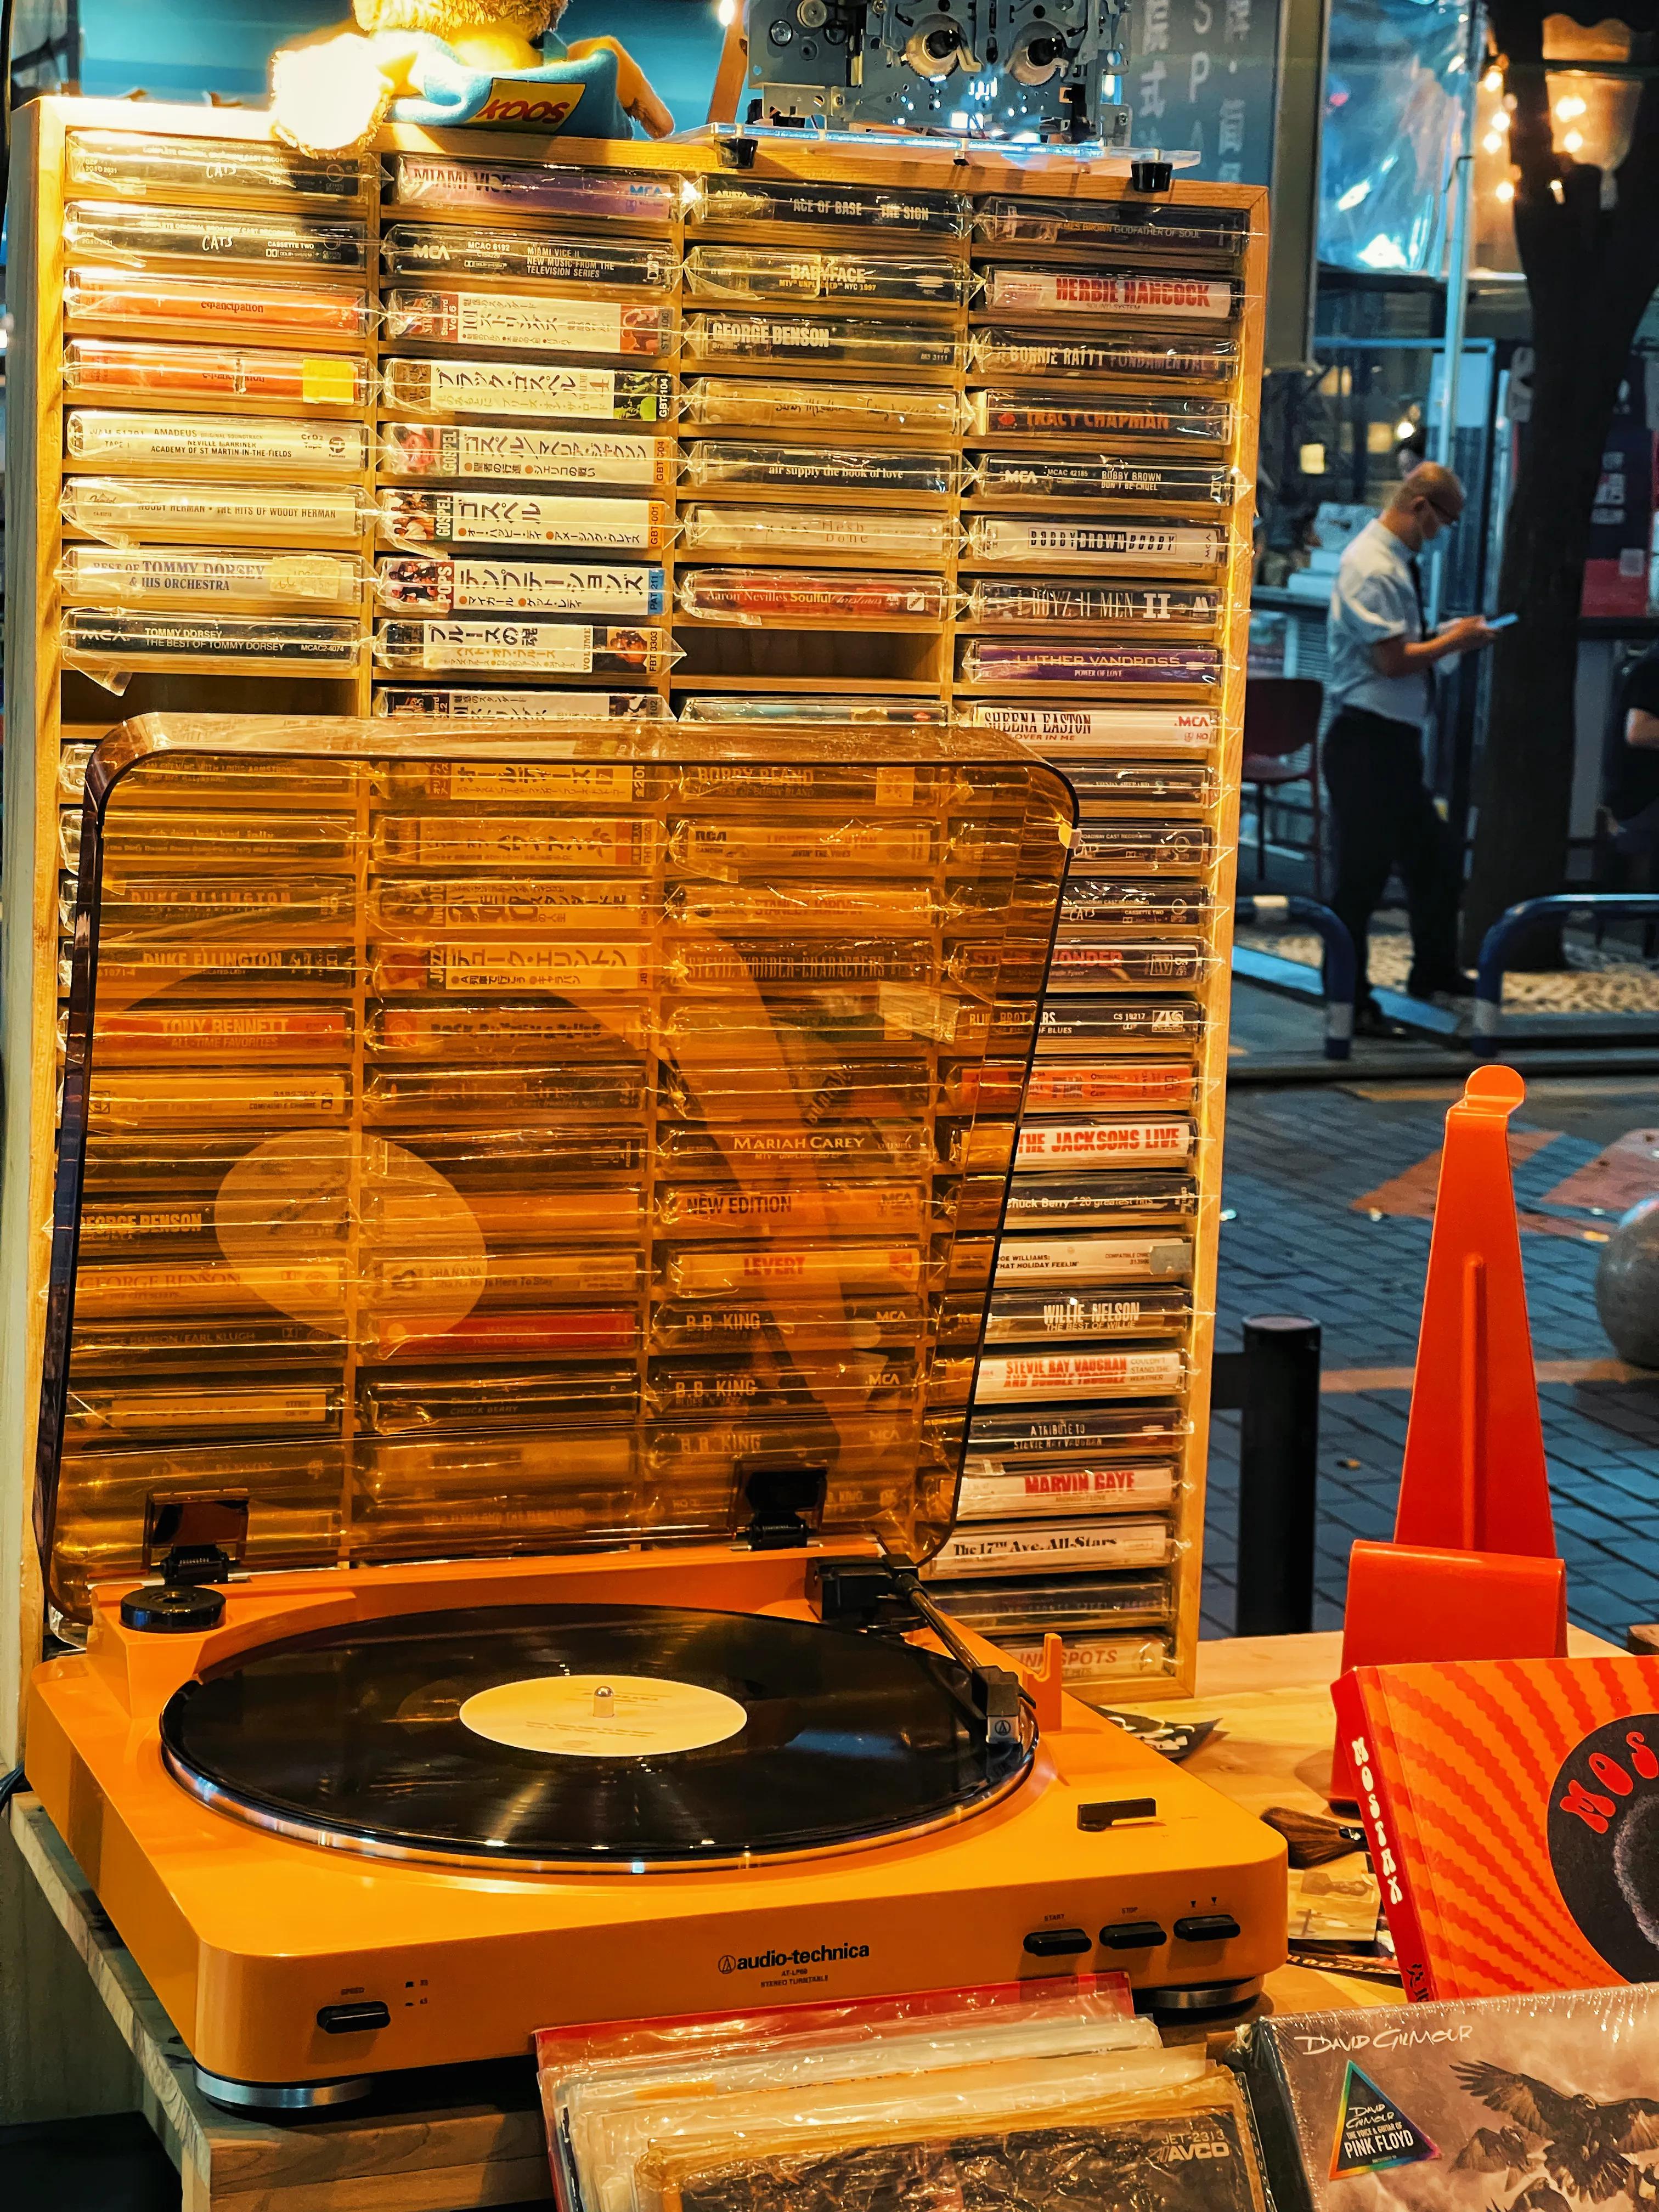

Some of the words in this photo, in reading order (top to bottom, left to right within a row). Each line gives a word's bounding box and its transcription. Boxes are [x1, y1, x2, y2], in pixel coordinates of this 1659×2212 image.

[475, 99, 570, 124] KOOS
[206, 163, 236, 179] CATS
[793, 199, 813, 213] ACE
[817, 200, 832, 213] OF
[835, 201, 862, 216] BASE
[881, 205, 900, 219] THE
[904, 206, 929, 220] SIGN
[202, 235, 233, 251] CATS
[467, 241, 490, 250] MCAC
[413, 244, 450, 261] MCA
[527, 257, 545, 266] NEW
[548, 258, 573, 267] MUSIC
[575, 259, 598, 270] FROM
[600, 261, 614, 270] THE
[527, 266, 571, 276] TELEVISION
[573, 268, 600, 278] SERIES
[1056, 278, 1118, 303] HERBIE
[1125, 281, 1210, 307] HANCOCK
[713, 323, 769, 344] GEORGE
[772, 326, 830, 347] BENSON
[437, 367, 577, 397] ブラック・ゴスペル
[589, 378, 610, 398] 4
[1026, 410, 1079, 428] TRACY
[1084, 411, 1169, 430] CHAPMAN
[211, 448, 292, 458] MARTIN-IN-THE-FIELDS
[443, 431, 458, 472] GOSPEL
[473, 462, 522, 475] 聖者の行進
[534, 465, 596, 478] ジェリコの戦い
[769, 465, 783, 475] air
[785, 465, 820, 478] supply
[823, 466, 839, 476] the
[842, 466, 868, 477] book
[870, 468, 881, 478] of
[883, 468, 904, 478] love
[1102, 471, 1128, 482] BOBBY
[1132, 472, 1161, 482] BROWN
[1005, 470, 1037, 484] MCA
[235, 506, 253, 515] HITS
[269, 508, 297, 517] WOODY
[301, 509, 336, 518] HERMAN
[436, 496, 452, 537] GOSPEL
[460, 499, 542, 524] ゴスペル
[650, 506, 659, 545] GBT-001
[125, 563, 140, 572] OF
[142, 560, 198, 577] TOMMY
[204, 562, 265, 579] DORSEY
[129, 578, 138, 586] &
[142, 577, 161, 588] HIS
[165, 579, 230, 591] ORCHESTRA
[437, 566, 452, 604] POPS
[460, 569, 644, 595] テンプテーションズ
[469, 595, 514, 607] マイガール
[527, 598, 583, 609] ゲット・レディ
[1080, 591, 1091, 617] II
[1101, 592, 1133, 618] MEN
[1143, 592, 1171, 619] II
[144, 628, 181, 637] TOMMY
[183, 629, 223, 639] DORSEY
[430, 624, 539, 647] ブルースの魂
[146, 638, 164, 647] THE
[166, 639, 191, 648] BEST
[194, 640, 207, 648] OF
[208, 640, 244, 650] TOMMY
[246, 642, 285, 651] DORSEY
[583, 628, 591, 671] VOLUME
[1015, 654, 1085, 667] LUTHER
[1090, 656, 1180, 667] VANDROSS
[984, 712, 1037, 732] SHEENA
[1043, 713, 1091, 735] EASTON
[696, 831, 727, 842] RCA
[1069, 909, 1095, 921] CATS
[143, 952, 188, 965] DUKE
[193, 951, 281, 967] ELLINGTON
[450, 949, 628, 967] デューク・エリントン
[537, 975, 581, 984] キャラバン
[163, 1018, 209, 1033] TONY
[215, 1018, 289, 1034] BENNETT
[171, 1037, 219, 1048] ALL-TIME
[221, 1037, 279, 1048] FAVORITES
[734, 1137, 806, 1150] MARIAH
[810, 1136, 866, 1149] CAREY
[1018, 1133, 1045, 1154] THE
[1051, 1130, 1139, 1153] JACKSONS
[1145, 1128, 1180, 1149] LIVE
[686, 1197, 724, 1216] NEW
[728, 1195, 792, 1214] EDITION
[1006, 1198, 1037, 1209] Chuck
[1041, 1198, 1070, 1209] Berry
[1079, 1196, 1092, 1206] 20
[1093, 1198, 1133, 1208] greatest
[140, 1213, 202, 1233] BENSON
[743, 1256, 805, 1277] LEVERT
[1043, 1304, 1085, 1324] WILLIE
[1092, 1302, 1140, 1322] NELSON
[1047, 1323, 1063, 1331] THE
[1066, 1322, 1090, 1331] BEST
[1091, 1322, 1104, 1330] OF
[1107, 1321, 1137, 1330] WILLIE
[1006, 1359, 1045, 1374] STEVIE
[1048, 1359, 1071, 1373] RAY
[1074, 1357, 1127, 1373] VAUGHAN
[1030, 1425, 1036, 1436] A
[1039, 1424, 1073, 1436] TRIBUTE
[1075, 1424, 1085, 1435] TO
[1025, 1474, 1089, 1494] MARVIN
[1094, 1471, 1135, 1493] GAYE
[954, 1544, 977, 1555] The
[1009, 1541, 1044, 1553] Ave.
[1047, 1536, 1118, 1551] All-Stars
[737, 1943, 870, 1970] audio-technica
[761, 1979, 787, 1988] STEREO
[789, 1975, 828, 1985] TURNTABLE
[1294, 2034, 1370, 2056] DAVID
[1372, 2024, 1474, 2051] GILMOUR
[1348, 2103, 1385, 2117] DAVID
[1161, 2129, 1225, 2145] JET-2313
[1344, 2136, 1376, 2159] PINK
[1375, 2130, 1414, 2152] FLOYD
[1168, 2142, 1230, 2162] AVCO
